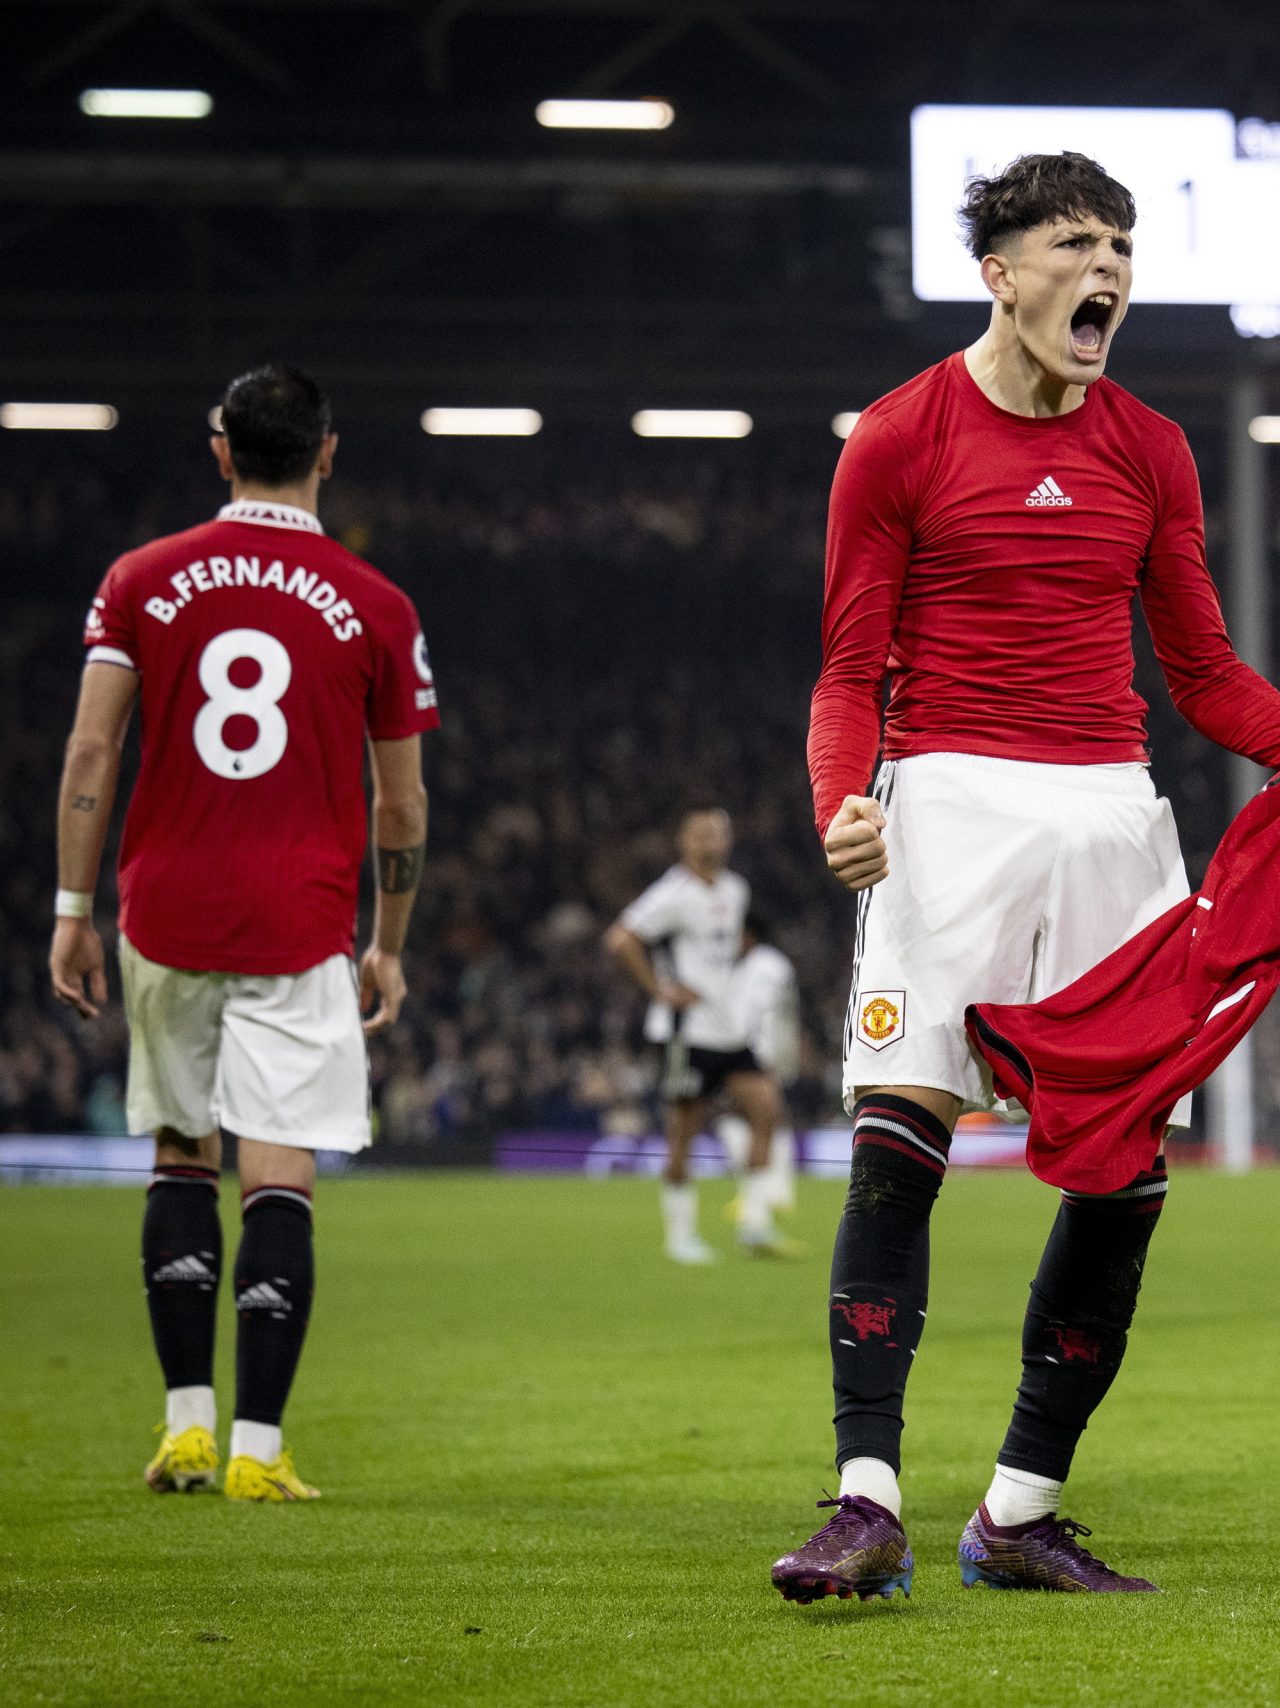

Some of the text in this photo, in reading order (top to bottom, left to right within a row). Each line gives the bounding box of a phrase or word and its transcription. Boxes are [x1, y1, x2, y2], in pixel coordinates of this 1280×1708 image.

[1177, 177, 1200, 255] 1
[1025, 495, 1073, 507] adidas
[144, 555, 363, 642] B.FERNANDES
[193, 627, 292, 781] 8
